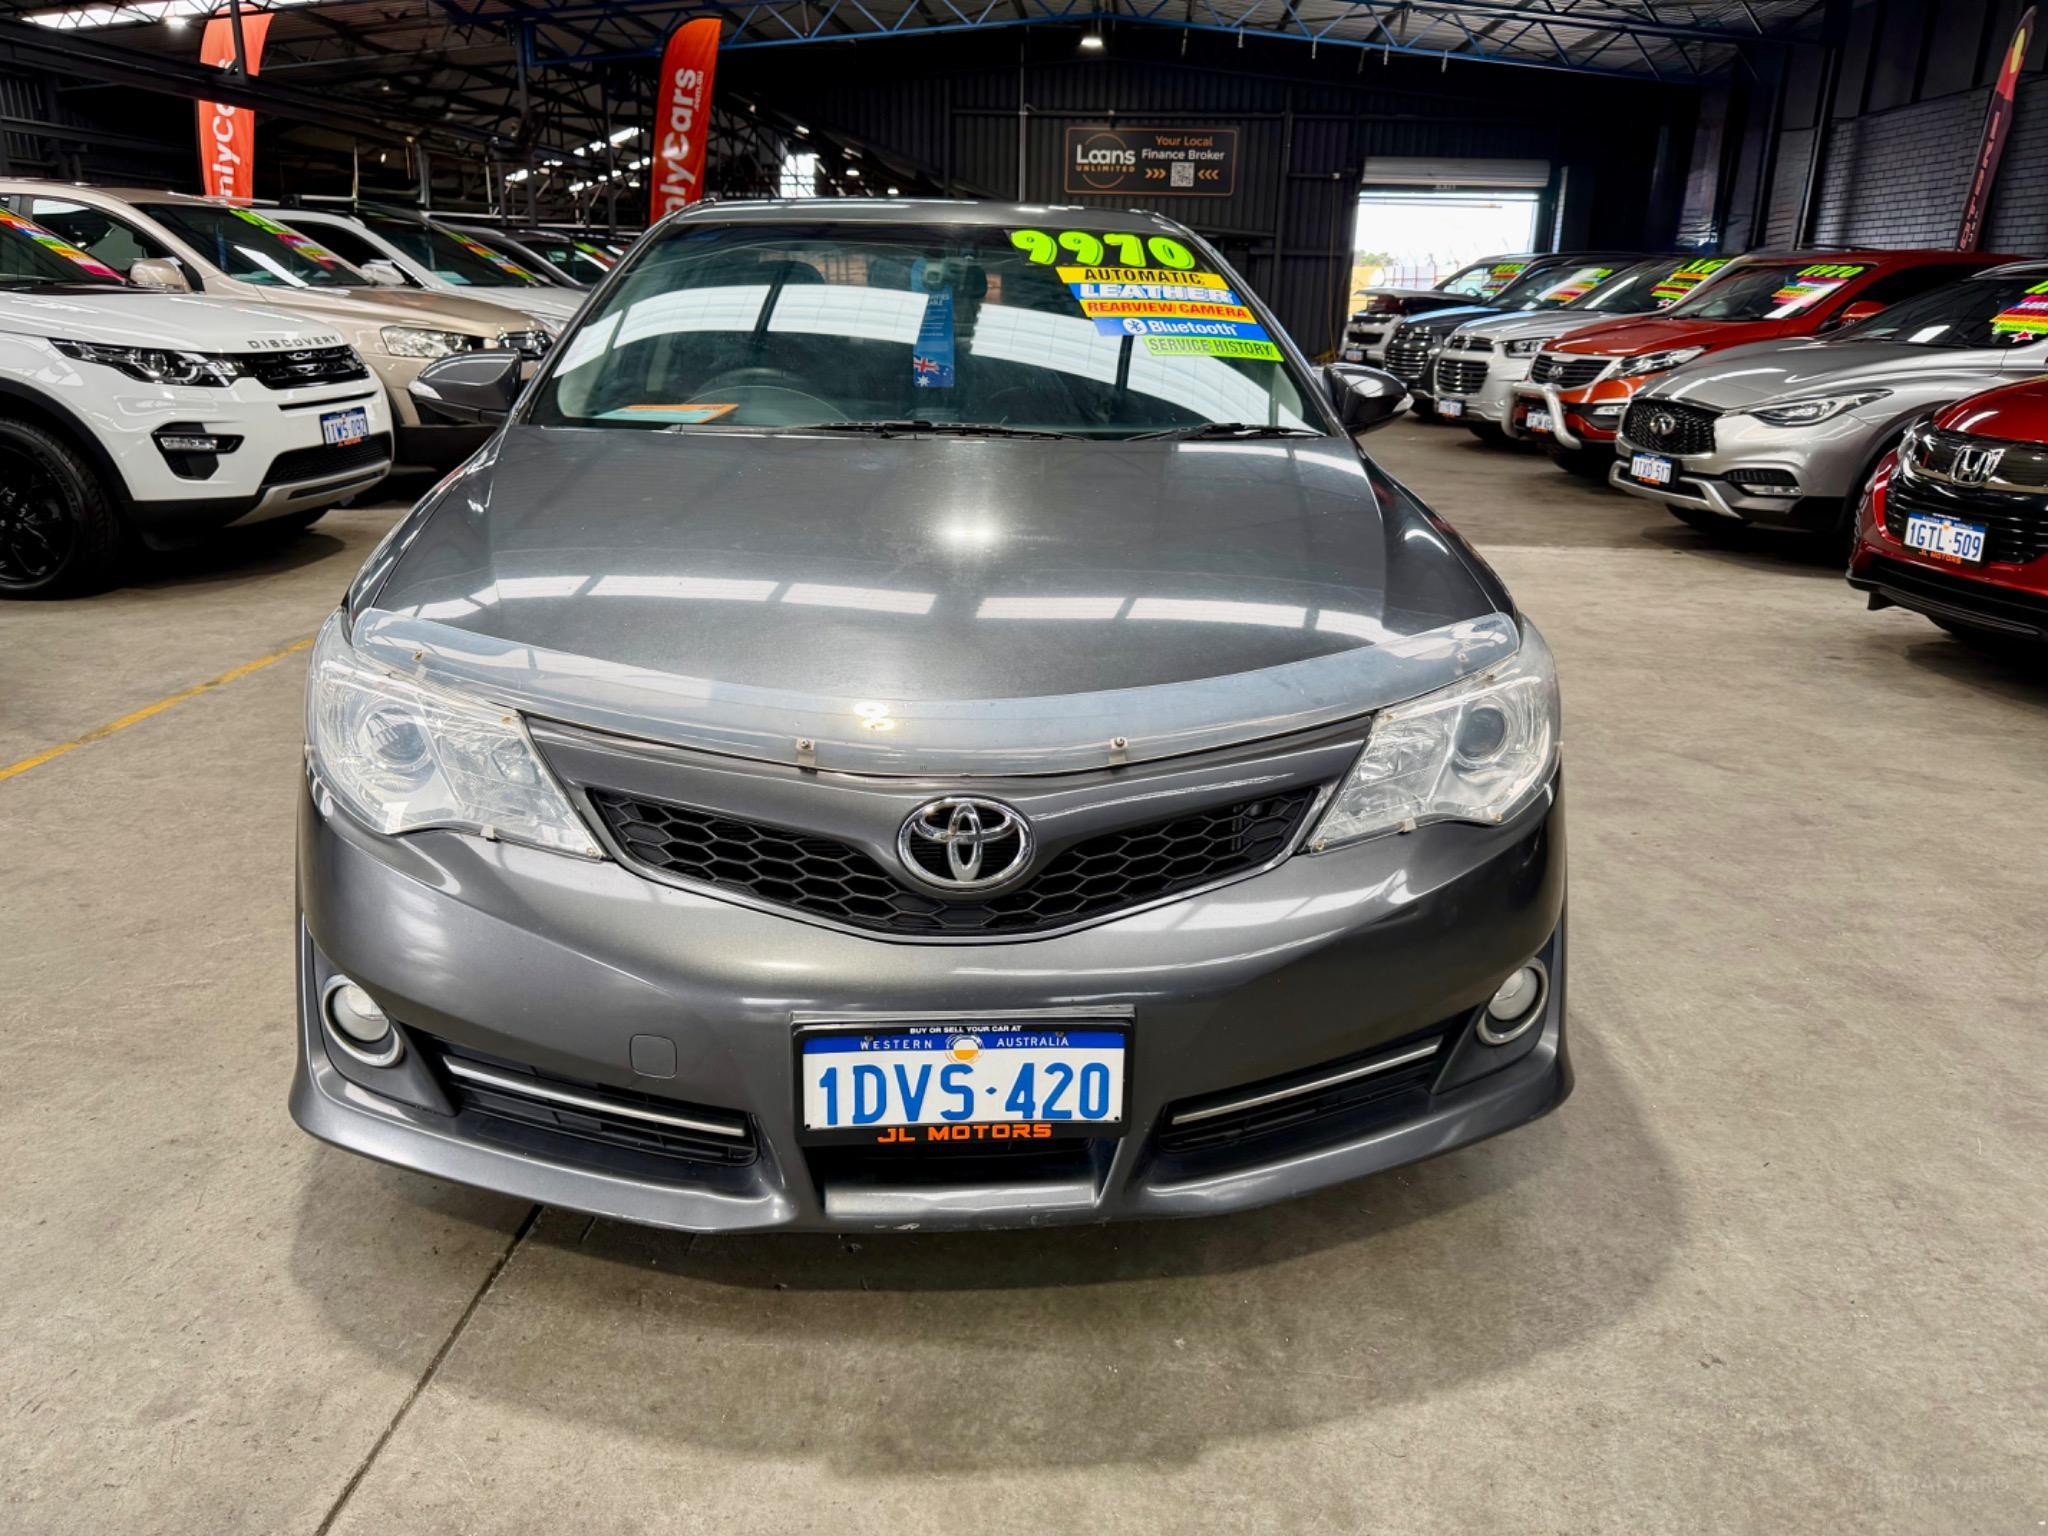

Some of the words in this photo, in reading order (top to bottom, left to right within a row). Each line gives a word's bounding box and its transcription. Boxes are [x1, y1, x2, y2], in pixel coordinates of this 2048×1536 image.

[1155, 136, 1181, 146] Your
[1184, 136, 1213, 147] Local
[1076, 144, 1136, 164] Loans
[1141, 148, 1185, 160] Finance
[1188, 149, 1225, 160] Broker
[1075, 165, 1136, 173] UNLIMITED
[1010, 229, 1195, 269] 9970
[1084, 268, 1203, 284] AUTOMATIC
[1080, 284, 1234, 304] LEATHER
[1087, 301, 1174, 313] REARVIEW
[1179, 303, 1248, 319] CAMERA
[1147, 320, 1235, 335] Bluetooth
[247, 336, 338, 349] DISCOVERY
[1150, 338, 1211, 353] SERVICE
[1213, 340, 1273, 356] HISTORY
[860, 1039, 932, 1050] WESTERN
[997, 1037, 1069, 1048] AUSTRALIA
[877, 1128, 915, 1144] JL
[928, 1124, 1052, 1142] MOTORS
